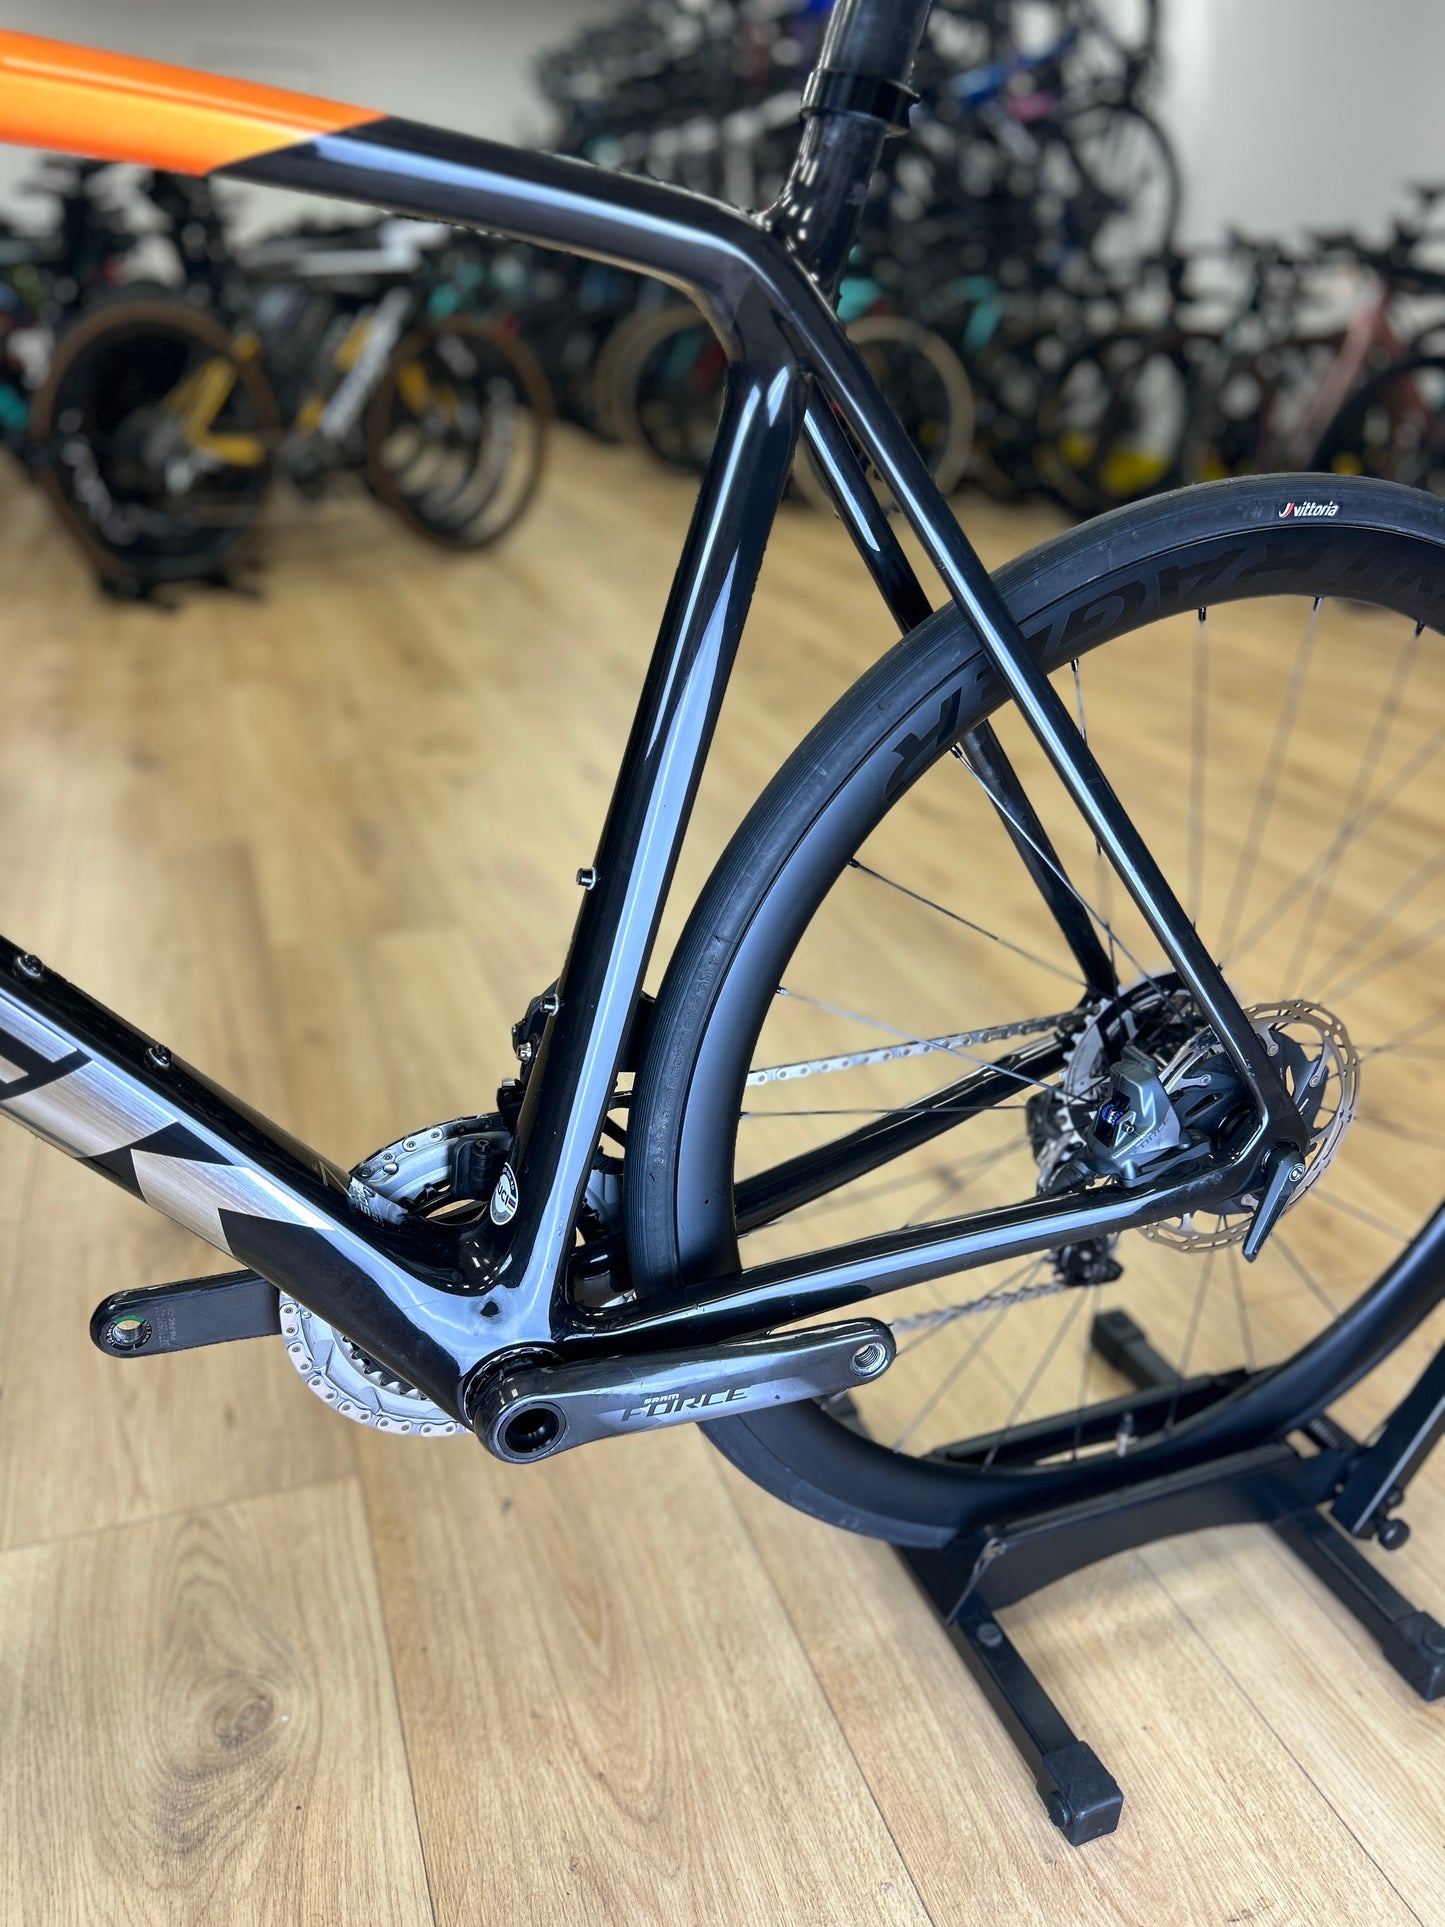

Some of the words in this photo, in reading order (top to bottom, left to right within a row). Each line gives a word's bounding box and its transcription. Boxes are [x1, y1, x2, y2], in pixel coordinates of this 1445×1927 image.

[1294, 501, 1339, 517] vittoria
[621, 1387, 750, 1421] FORCE
[643, 1393, 679, 1405] SRAM
